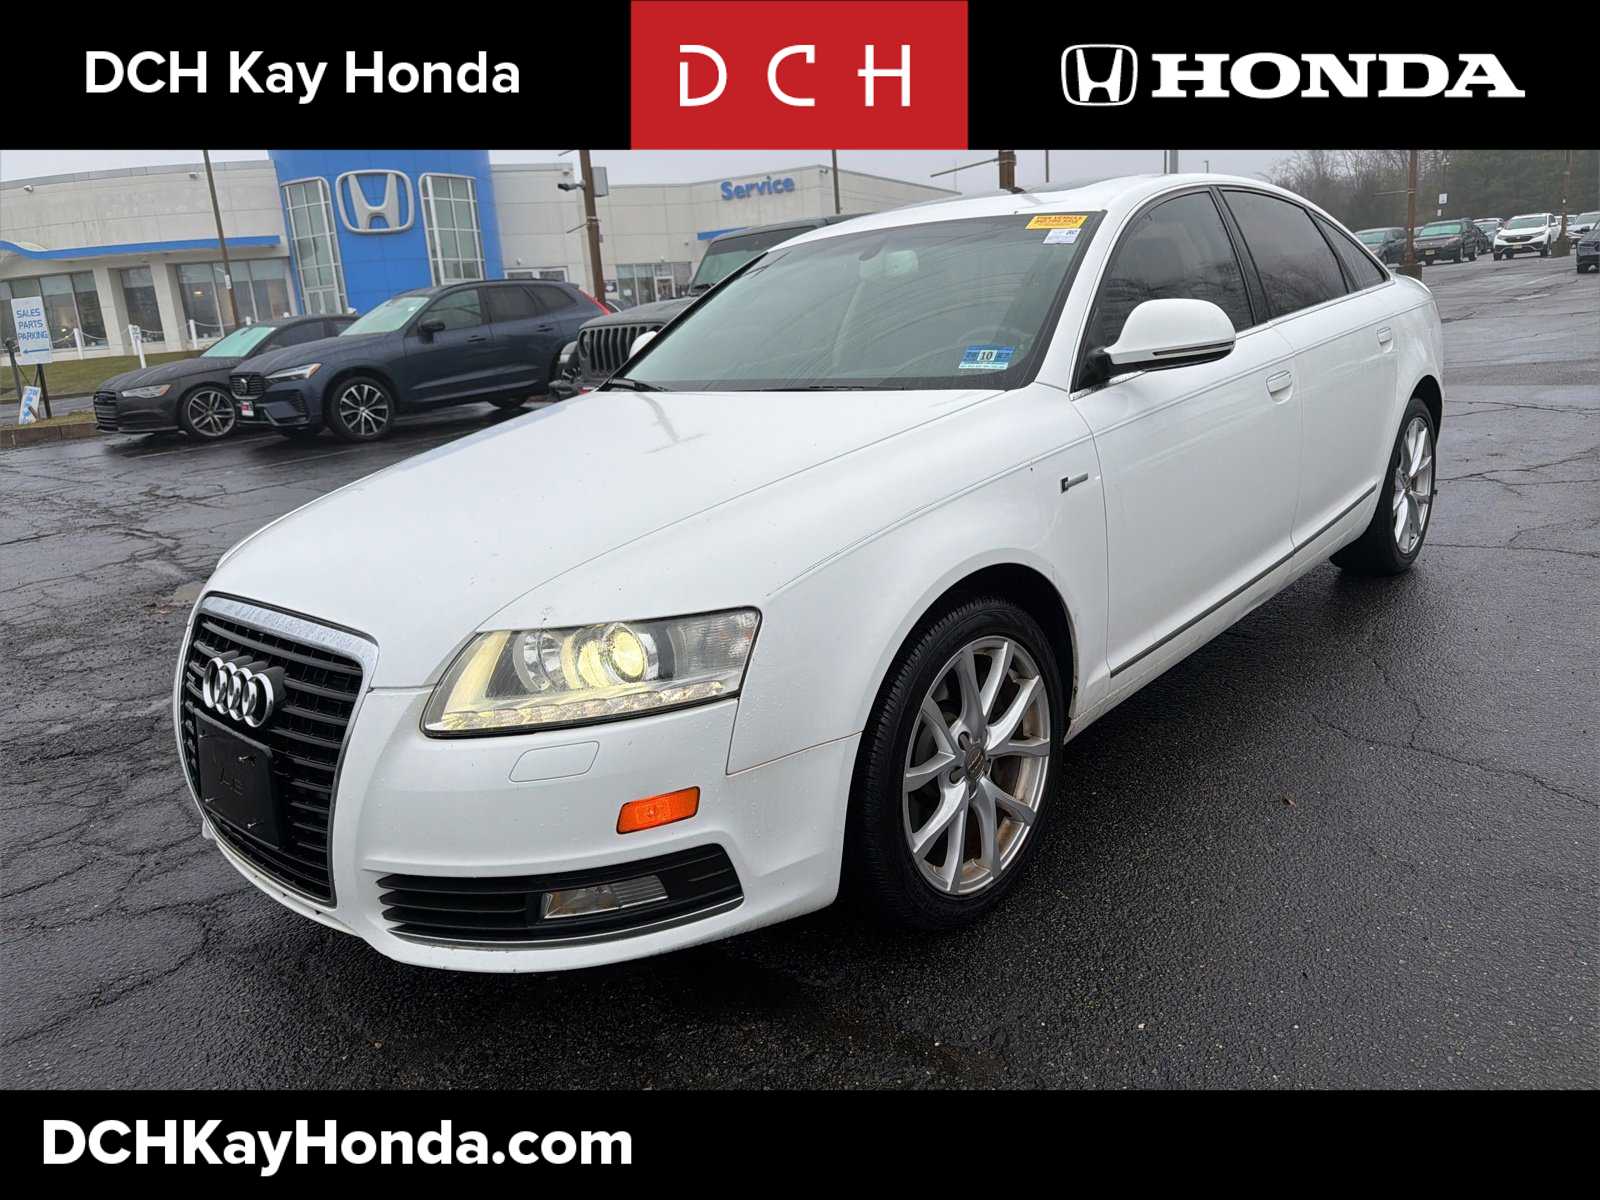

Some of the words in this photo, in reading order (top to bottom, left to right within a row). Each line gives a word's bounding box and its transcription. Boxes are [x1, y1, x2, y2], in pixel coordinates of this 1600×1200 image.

[720, 176, 795, 200] Service
[16, 308, 41, 318] SALES
[18, 319, 43, 329] PARTS
[18, 330, 48, 341] PARKING
[981, 351, 993, 360] 10
